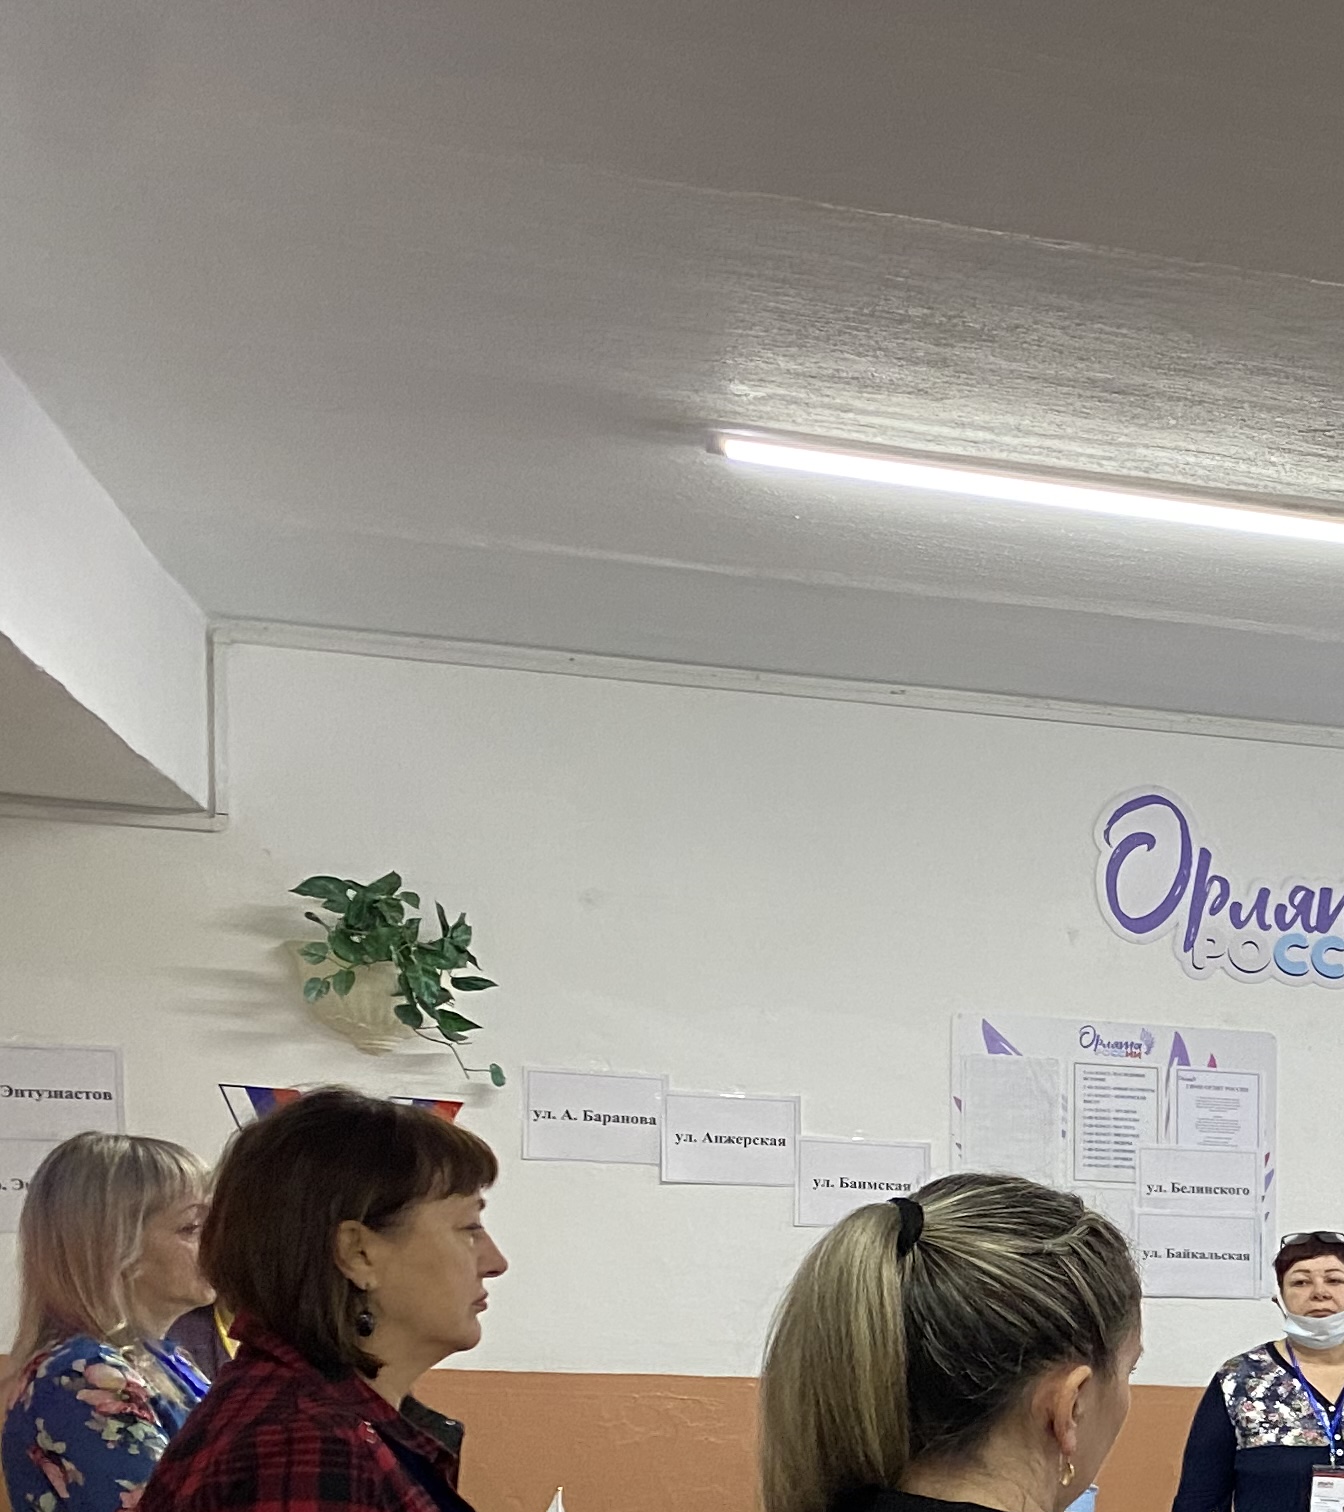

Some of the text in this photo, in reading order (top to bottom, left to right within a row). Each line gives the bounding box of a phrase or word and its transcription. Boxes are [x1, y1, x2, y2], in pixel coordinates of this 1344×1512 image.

[532, 1109, 657, 1126] ул. А. Баранова
[674, 1132, 787, 1149] ул. Анжерская
[812, 1178, 835, 1191] ул.
[1146, 1181, 1250, 1197] ул. Белинского
[1142, 1246, 1251, 1262] ул. Байкальская
